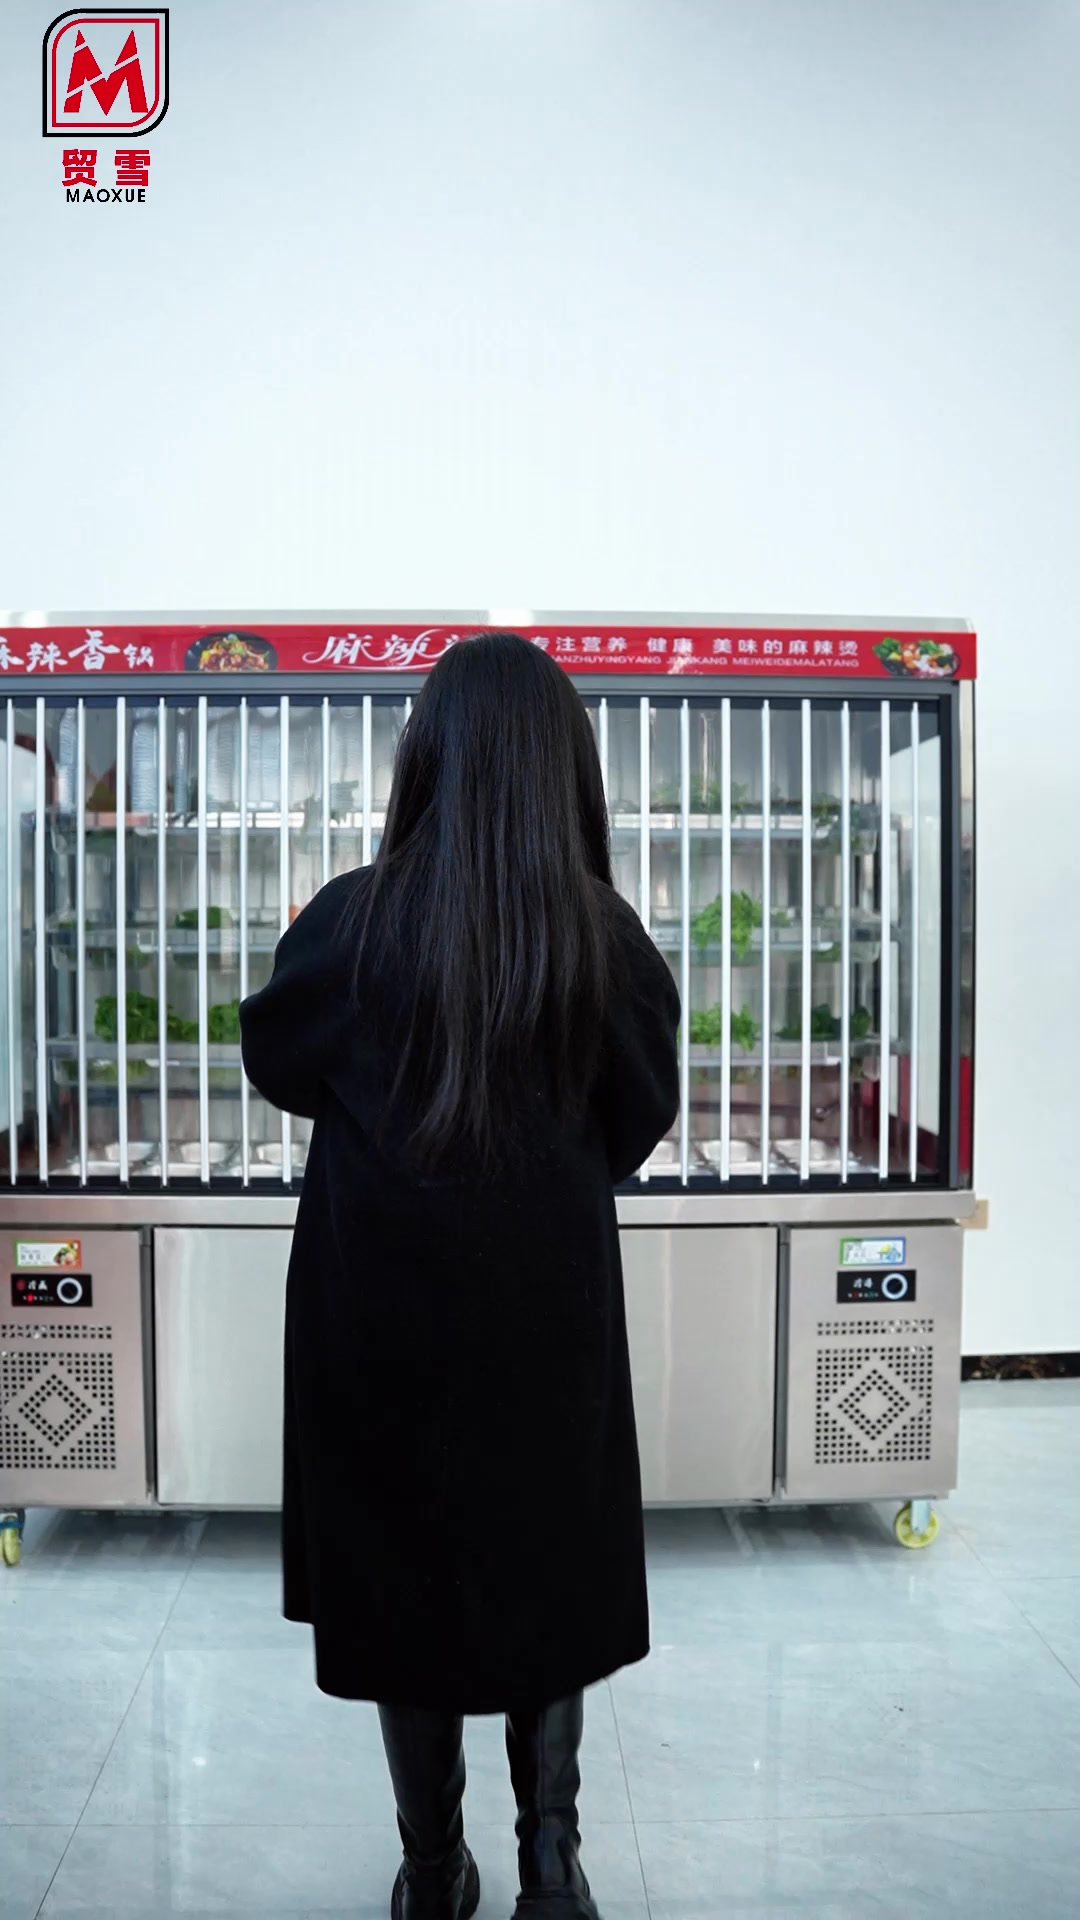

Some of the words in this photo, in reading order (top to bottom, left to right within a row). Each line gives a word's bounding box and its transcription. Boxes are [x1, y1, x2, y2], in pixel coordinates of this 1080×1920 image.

[302, 628, 460, 671] 麻辣
[530, 635, 628, 653] 专注营养
[647, 637, 693, 653] 健康
[713, 638, 858, 656] 美味的麻辣烫
[551, 655, 662, 665] ANZHUYINGYANG
[732, 657, 859, 668] MEIWEIDEMALATANG
